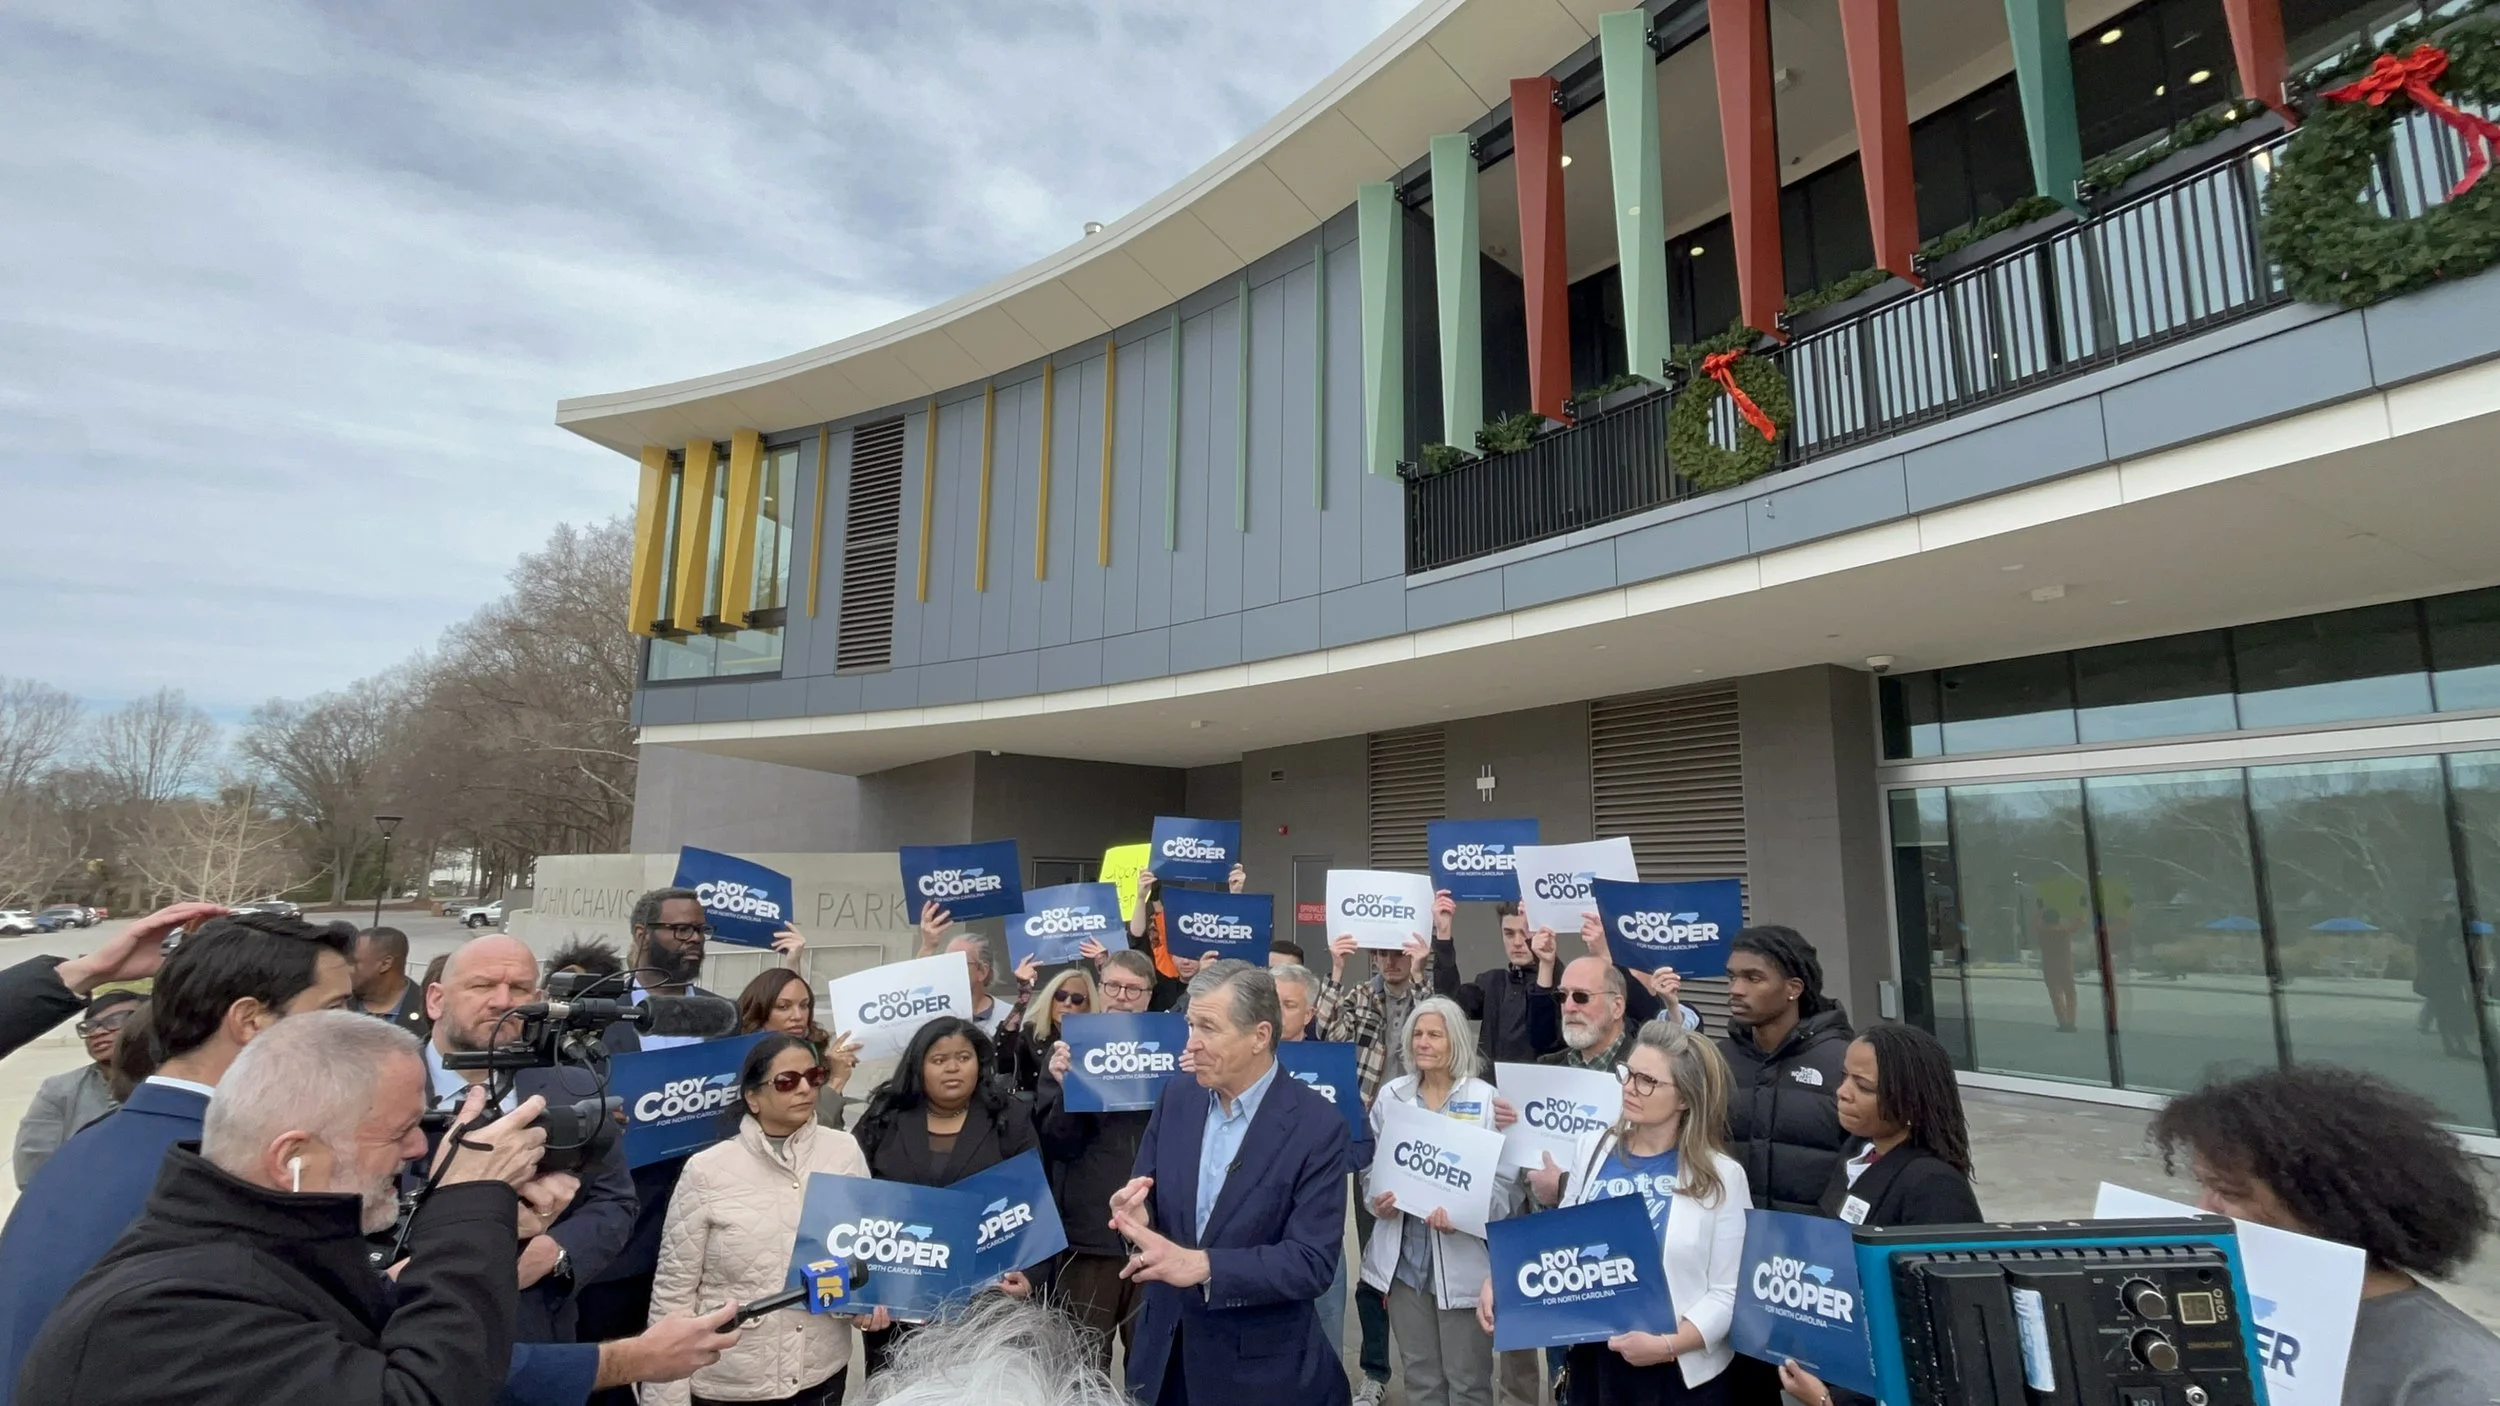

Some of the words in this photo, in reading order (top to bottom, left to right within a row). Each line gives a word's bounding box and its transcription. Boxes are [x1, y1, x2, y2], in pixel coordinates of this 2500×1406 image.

[1162, 839, 1226, 860] COOPER
[1176, 837, 1199, 847] ROY
[1457, 844, 1484, 856] ROY
[918, 875, 1002, 896] COOPER
[933, 869, 962, 882] ROY
[1547, 872, 1573, 884] ROY
[716, 880, 748, 898] ROY
[1357, 893, 1383, 904] ROY
[1534, 878, 1589, 900] COOP
[571, 887, 634, 919] CHAVIS
[816, 891, 908, 932] PARK
[694, 882, 780, 920] COOPER
[1341, 897, 1416, 920] COOPER
[1042, 907, 1071, 920] ROY
[1193, 912, 1220, 924] ROY
[1635, 911, 1672, 926] ROY
[1024, 914, 1107, 936] COOPER
[1178, 914, 1253, 939] COOPER
[1617, 914, 1720, 944] COOPER
[878, 989, 910, 1005] ROY
[858, 994, 951, 1024] COOPER
[1106, 1042, 1138, 1056] ROY
[1084, 1048, 1175, 1074] COOPER
[664, 1076, 708, 1098] ROY
[1545, 1097, 1577, 1114] ROY
[656, 1119, 670, 1127] FOR
[672, 1114, 696, 1124] NORTH
[1413, 1140, 1441, 1159] ROY
[1394, 1142, 1472, 1192] COOPER
[858, 1218, 903, 1239] ROY
[826, 1223, 950, 1269] COOPER
[866, 1263, 886, 1272] ORTH
[886, 1265, 922, 1276] CAROLINA
[1540, 1247, 1580, 1272] ROY
[1771, 1256, 1806, 1281] ROY
[1518, 1257, 1638, 1298] COOPER
[1558, 1294, 1580, 1304] NORTH
[1581, 1288, 1616, 1300] CAROLINA
[1752, 1262, 1854, 1323] COOPER
[1776, 1306, 1795, 1319] NORTH
[1795, 1312, 1828, 1328] CAROLINA
